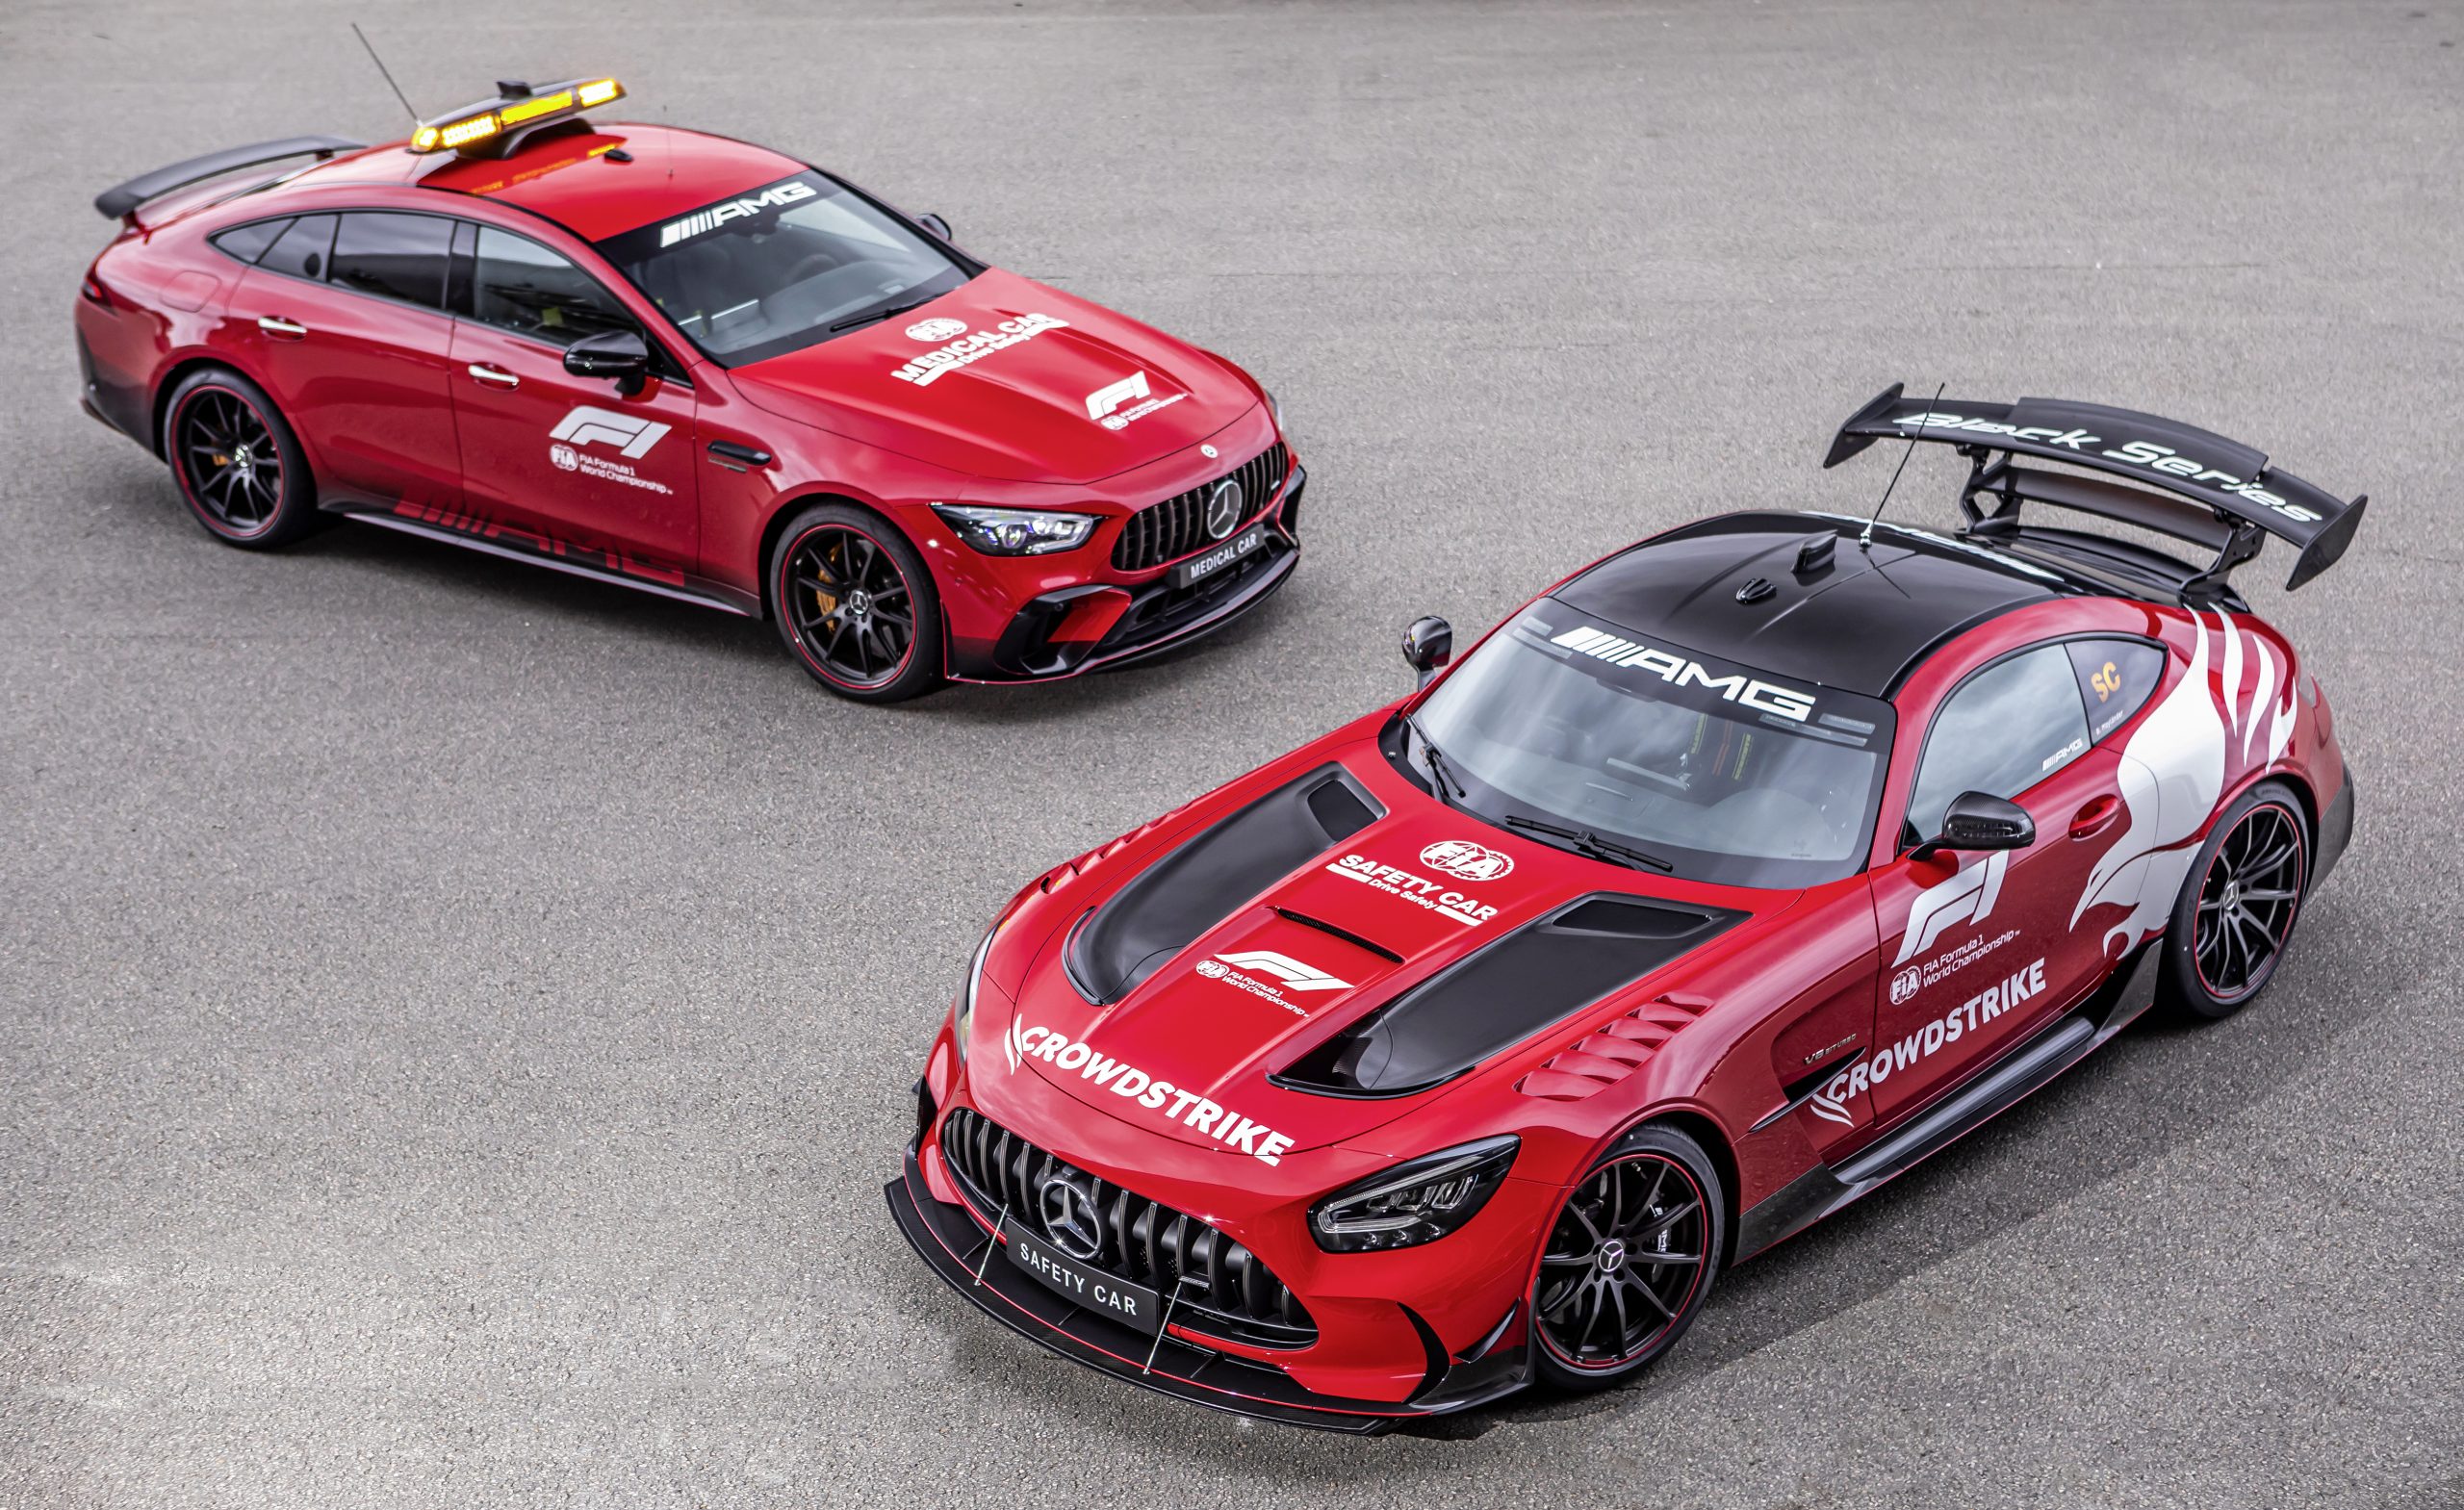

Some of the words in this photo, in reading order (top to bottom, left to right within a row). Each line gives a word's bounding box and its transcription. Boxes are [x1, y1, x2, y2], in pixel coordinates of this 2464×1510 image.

[890, 330, 1008, 382] MEDICAL
[997, 313, 1057, 334] CAR
[1085, 370, 1151, 421] F1
[549, 404, 673, 460] F1
[551, 445, 578, 469] FIA
[579, 453, 594, 465] FIA
[594, 457, 630, 475] Formula
[629, 466, 636, 476] 1
[579, 464, 605, 478] World
[1892, 412, 2101, 450] Black
[2102, 440, 2323, 524] Series
[1190, 547, 1236, 579] MEDICAL
[1238, 533, 1257, 554] CAR
[2091, 661, 2121, 704] SC
[1420, 840, 1500, 881] FIA
[1339, 854, 1444, 895] SAFETY
[1438, 891, 1499, 921] CAR
[1368, 879, 1400, 894] Drive
[1399, 890, 1438, 909] Safely
[1890, 849, 2010, 969] F1
[1213, 950, 1355, 991] F1
[1923, 958, 1939, 976] FIA
[1939, 936, 1979, 964] Formula
[1978, 934, 1984, 945] 1
[1923, 965, 1951, 987] World
[1221, 976, 1248, 989] World
[1227, 971, 1245, 981] FIA
[1242, 977, 1278, 995] Formula
[1890, 970, 1920, 1000] FIA
[1826, 957, 2047, 1105] CROWDSTRIKE
[1020, 1026, 1296, 1167] CROWDSTRIKE
[1019, 1242, 1086, 1293] SAFETY
[1093, 1285, 1137, 1316] CAR
